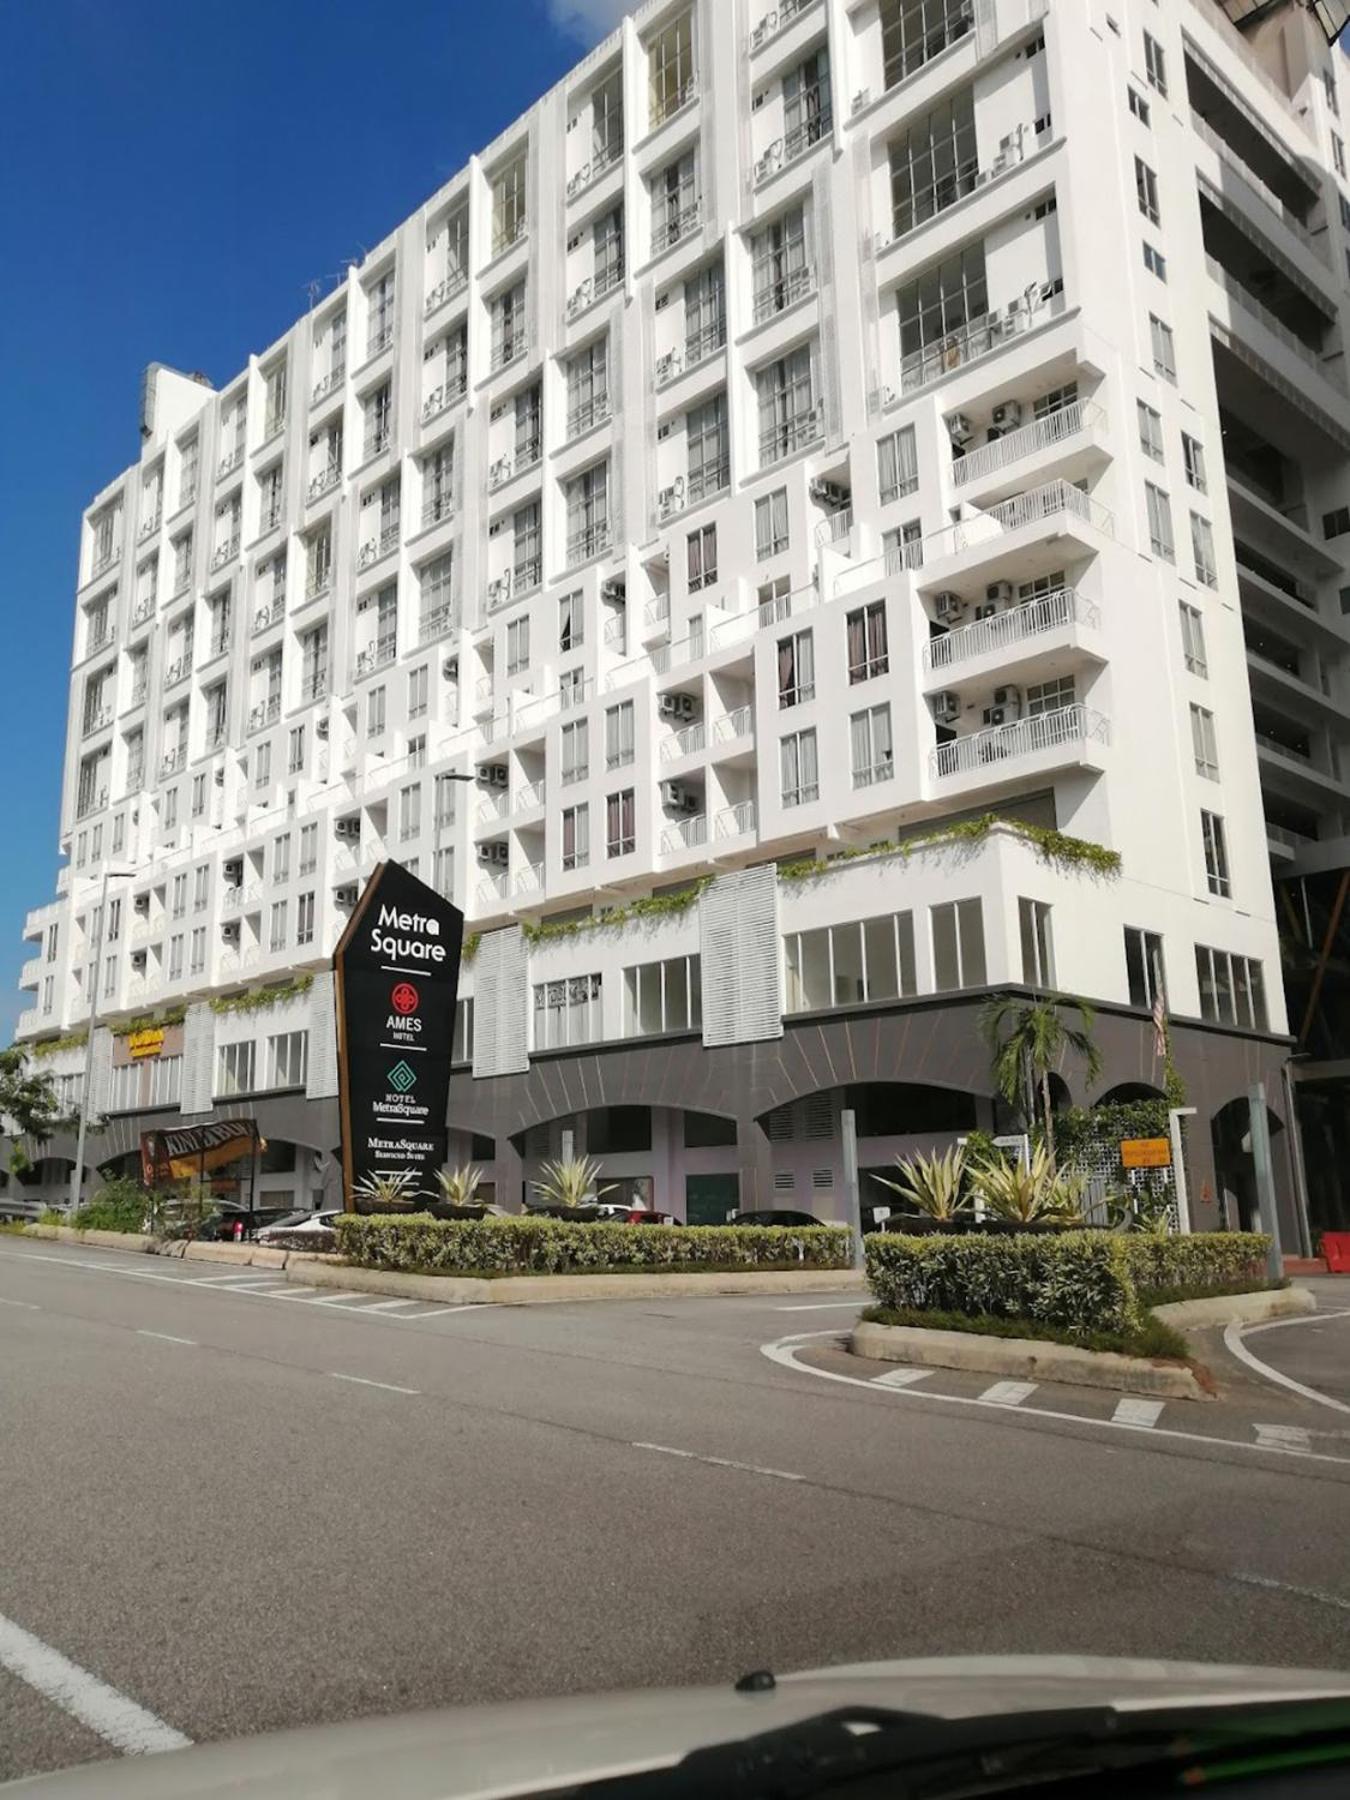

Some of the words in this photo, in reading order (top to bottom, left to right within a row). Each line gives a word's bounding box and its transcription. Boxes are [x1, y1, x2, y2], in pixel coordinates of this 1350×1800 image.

[378, 903, 440, 936] Metra
[370, 928, 446, 962] Square
[386, 1015, 422, 1032] AMES
[385, 1093, 417, 1104] HOTEL
